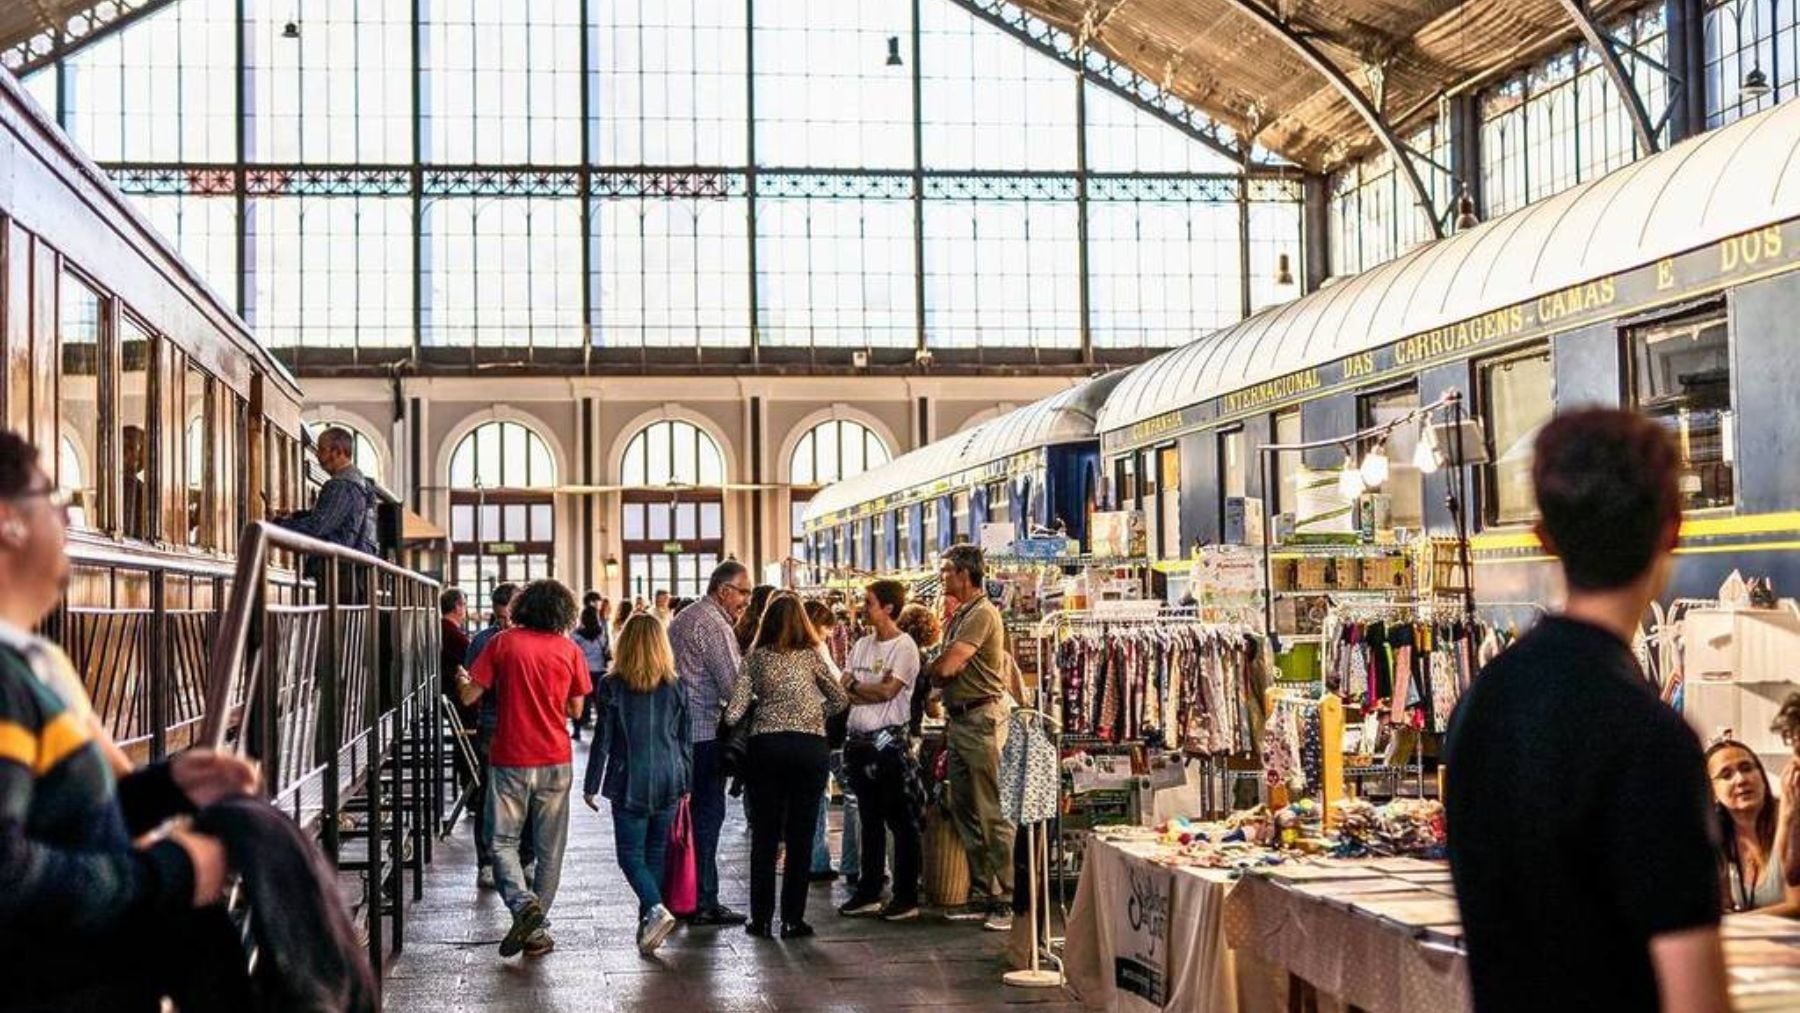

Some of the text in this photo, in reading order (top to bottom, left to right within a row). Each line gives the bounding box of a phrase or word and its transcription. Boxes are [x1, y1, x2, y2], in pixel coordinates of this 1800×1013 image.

[1224, 367, 1321, 413] INTERNACIONAL
[1343, 352, 1374, 379] DAS
[1656, 258, 1675, 291] E
[1721, 224, 1783, 272] DOS
